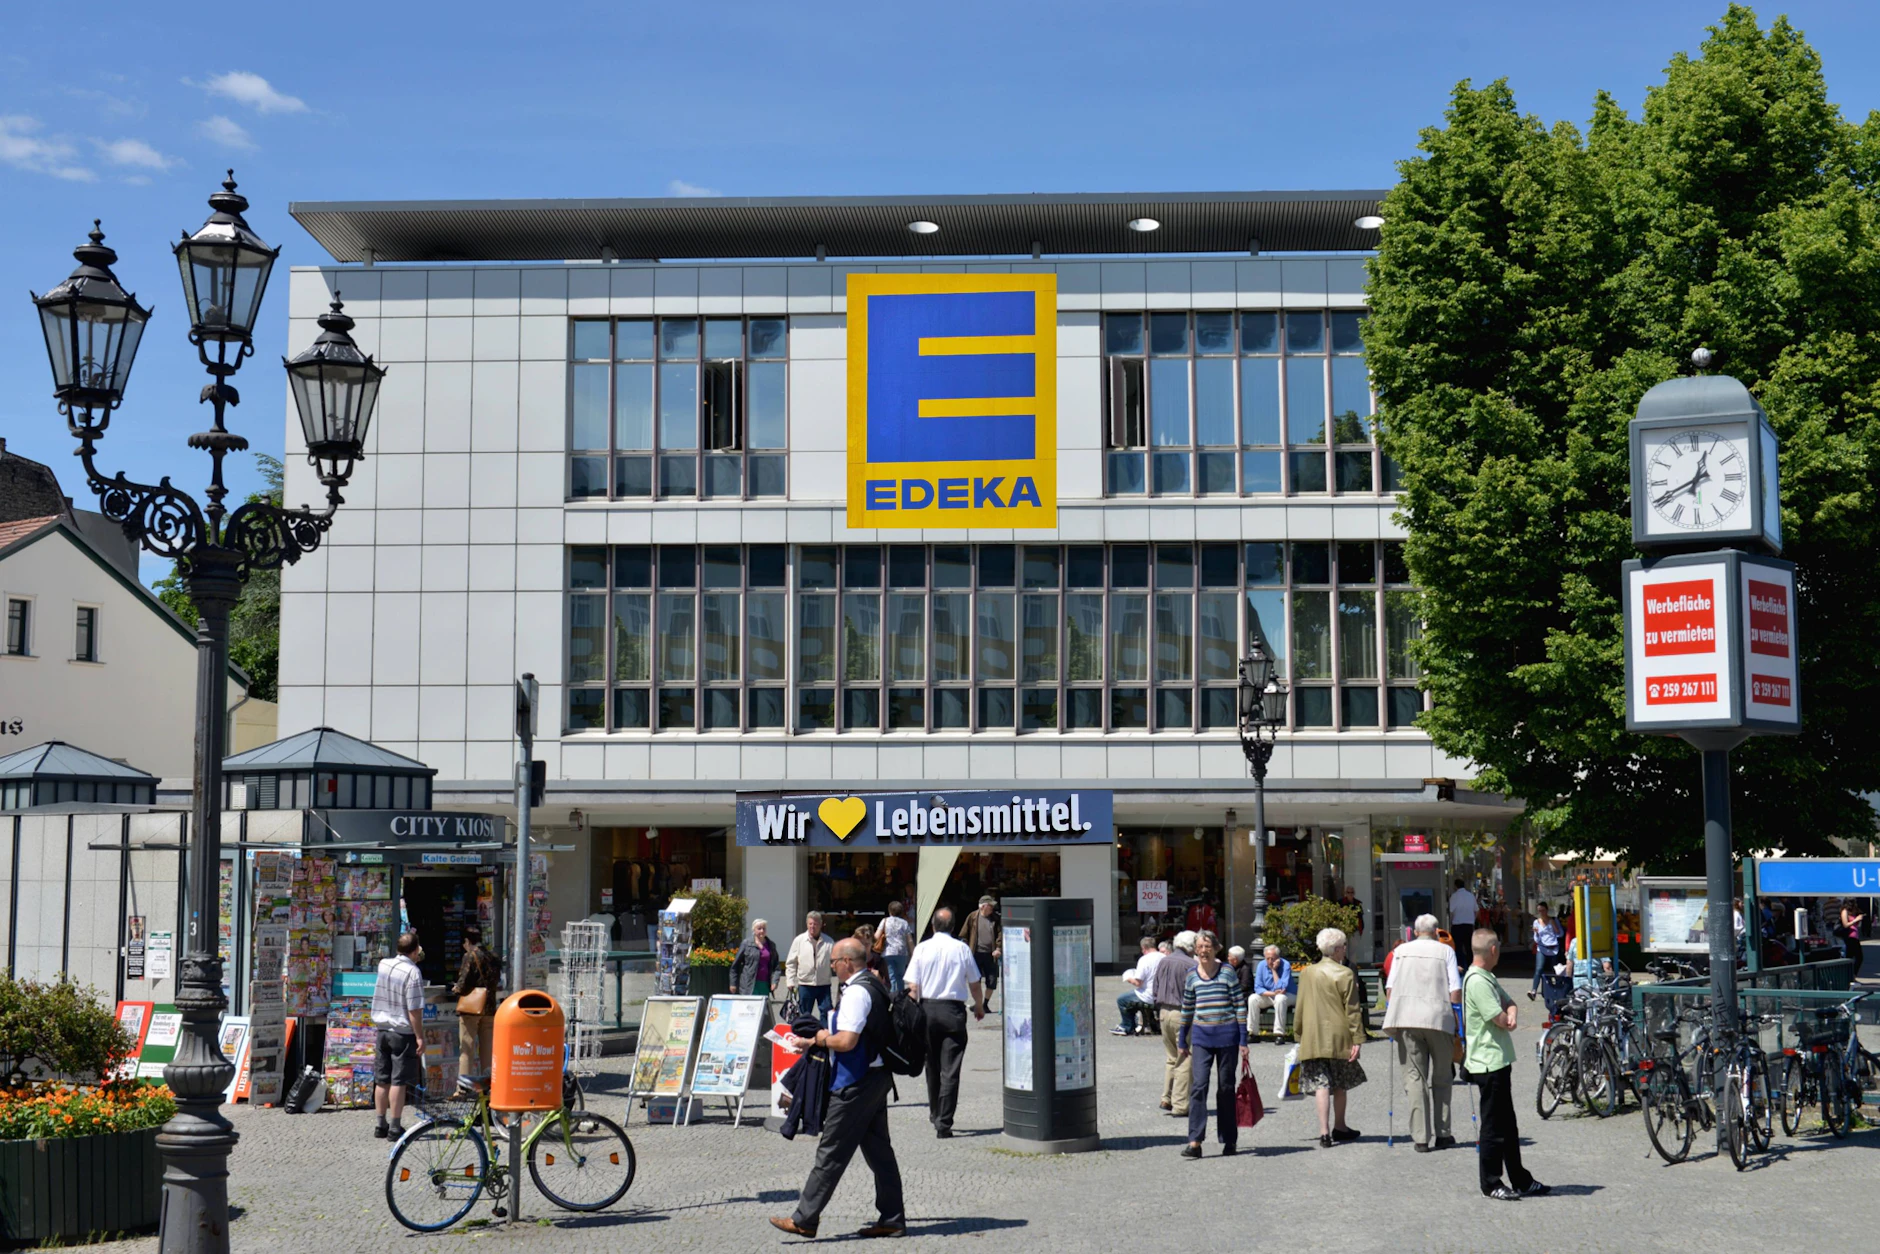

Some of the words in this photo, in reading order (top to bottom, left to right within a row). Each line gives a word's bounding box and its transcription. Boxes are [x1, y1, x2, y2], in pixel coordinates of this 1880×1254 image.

[866, 476, 1042, 510] EDEKA
[1646, 594, 1711, 614] Werbefläche
[1750, 595, 1786, 616] Werbefläche
[1645, 631, 1658, 645] zu
[1660, 623, 1714, 643] vermieten
[1751, 628, 1758, 641] zu
[1759, 626, 1788, 646] vermieten
[1662, 683, 1680, 697] 259
[1682, 682, 1699, 696] 267
[1701, 681, 1715, 695] 111
[1761, 683, 1771, 697] 259
[1771, 683, 1781, 698] 267
[1781, 685, 1790, 699] 111
[756, 803, 809, 840] Wir
[876, 793, 1093, 837] Lebensmittel.
[390, 816, 449, 836] CITY
[423, 855, 448, 863] Kalte
[450, 855, 481, 863] Getränke
[1142, 882, 1163, 891] JETZT
[1142, 891, 1163, 900] 20%
[190, 921, 197, 936] 3
[512, 1045, 534, 1056] Wow!
[535, 1045, 555, 1056] Wow!
